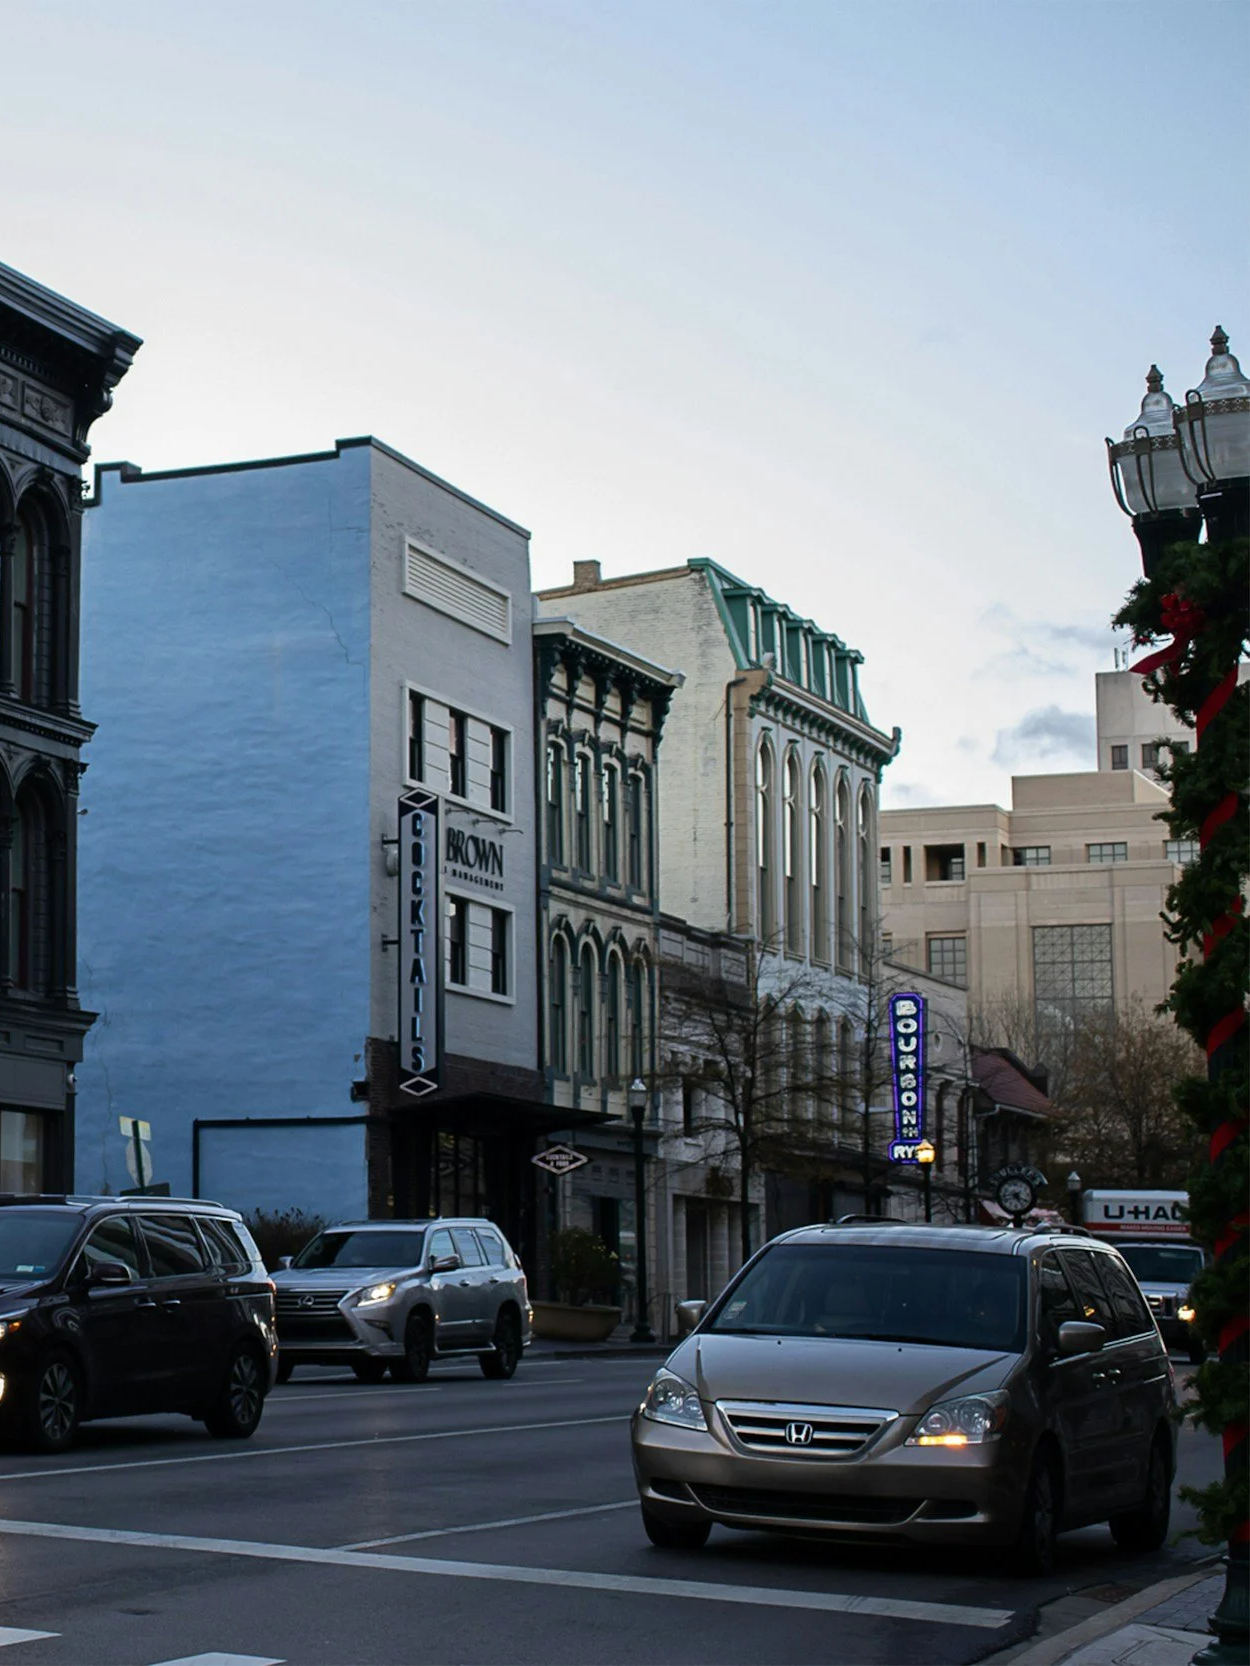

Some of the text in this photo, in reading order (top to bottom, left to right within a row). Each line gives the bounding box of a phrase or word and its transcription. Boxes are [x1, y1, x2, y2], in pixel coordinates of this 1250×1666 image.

[445, 827, 503, 878] BROWN
[452, 868, 504, 891] MANAGEMENT
[410, 812, 426, 1073] COCKTAILS
[896, 1000, 917, 1125] BOURBON
